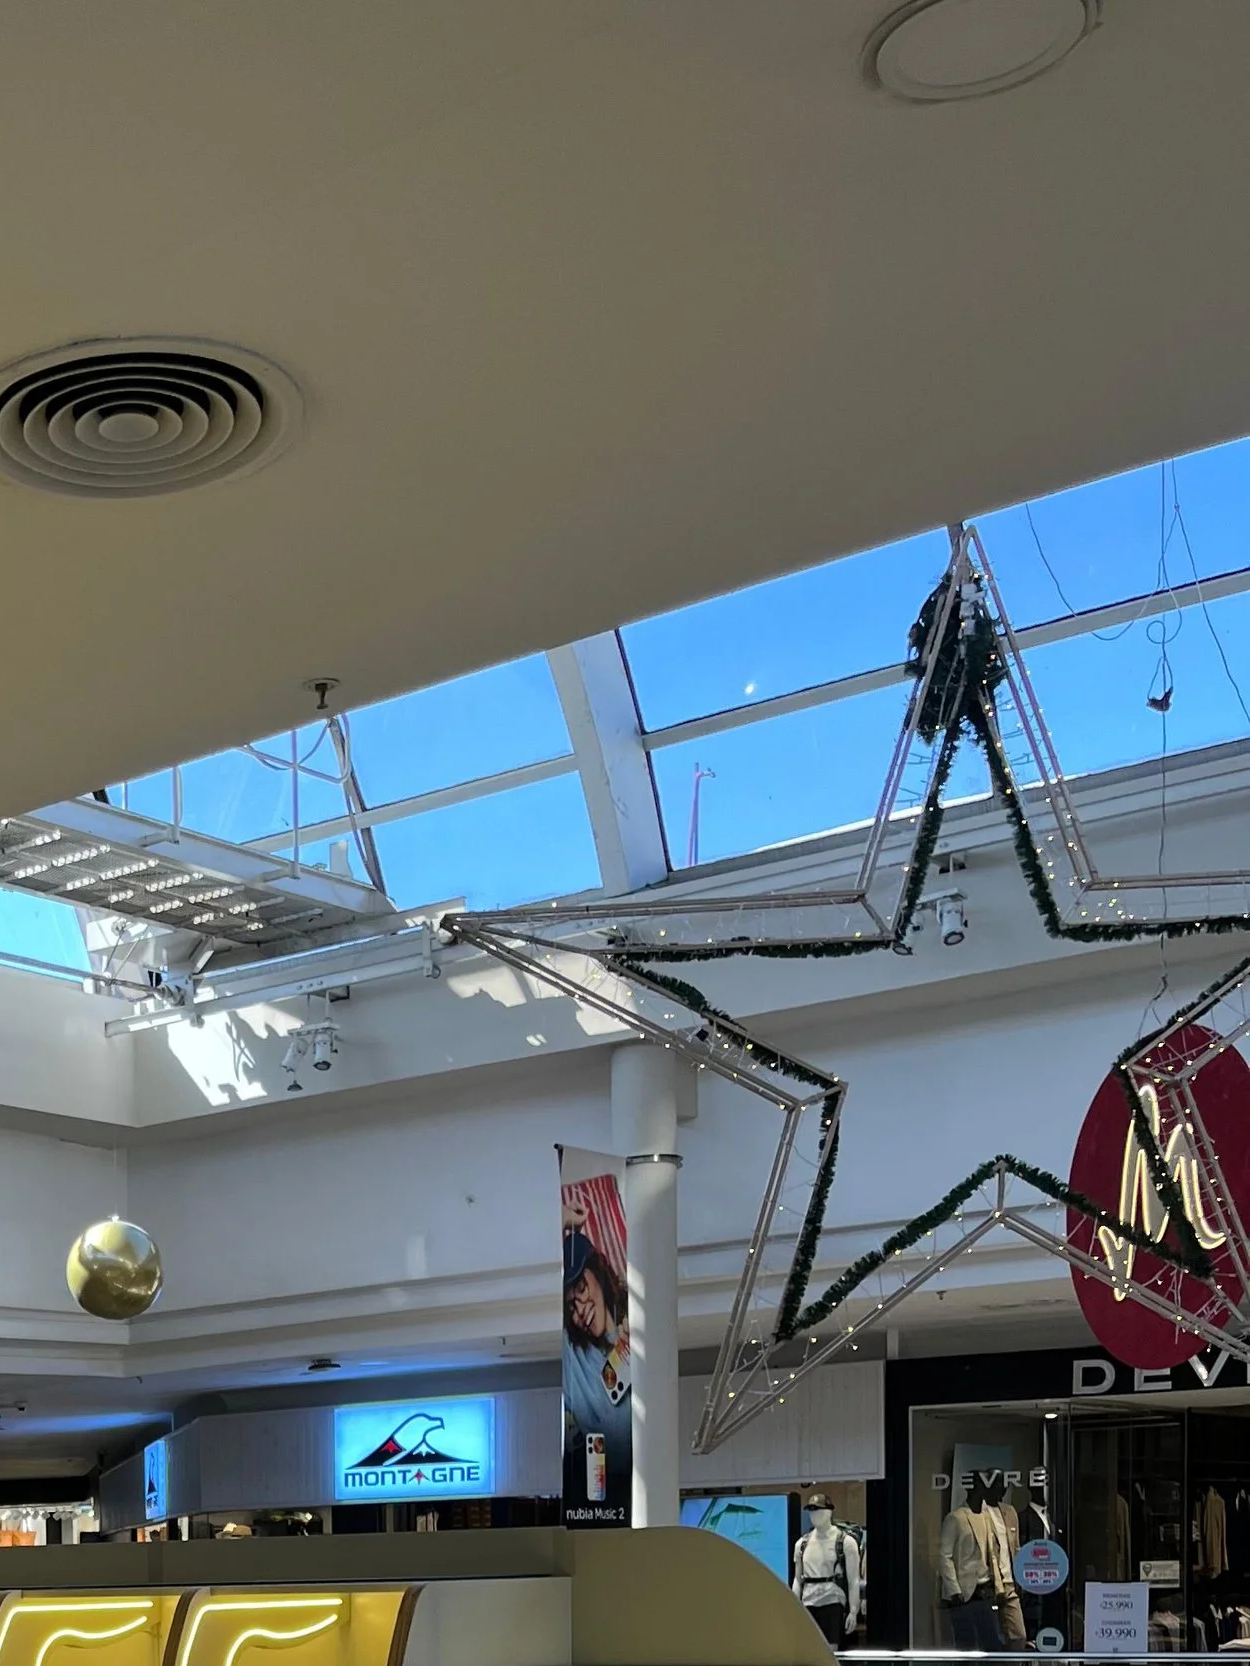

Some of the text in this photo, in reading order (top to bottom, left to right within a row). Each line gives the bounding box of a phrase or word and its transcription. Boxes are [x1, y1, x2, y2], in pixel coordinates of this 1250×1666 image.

[1072, 1350, 1250, 1395] DEV
[344, 1465, 480, 1487] MONTAGNE
[566, 1507, 625, 1520] nubia Music 2
